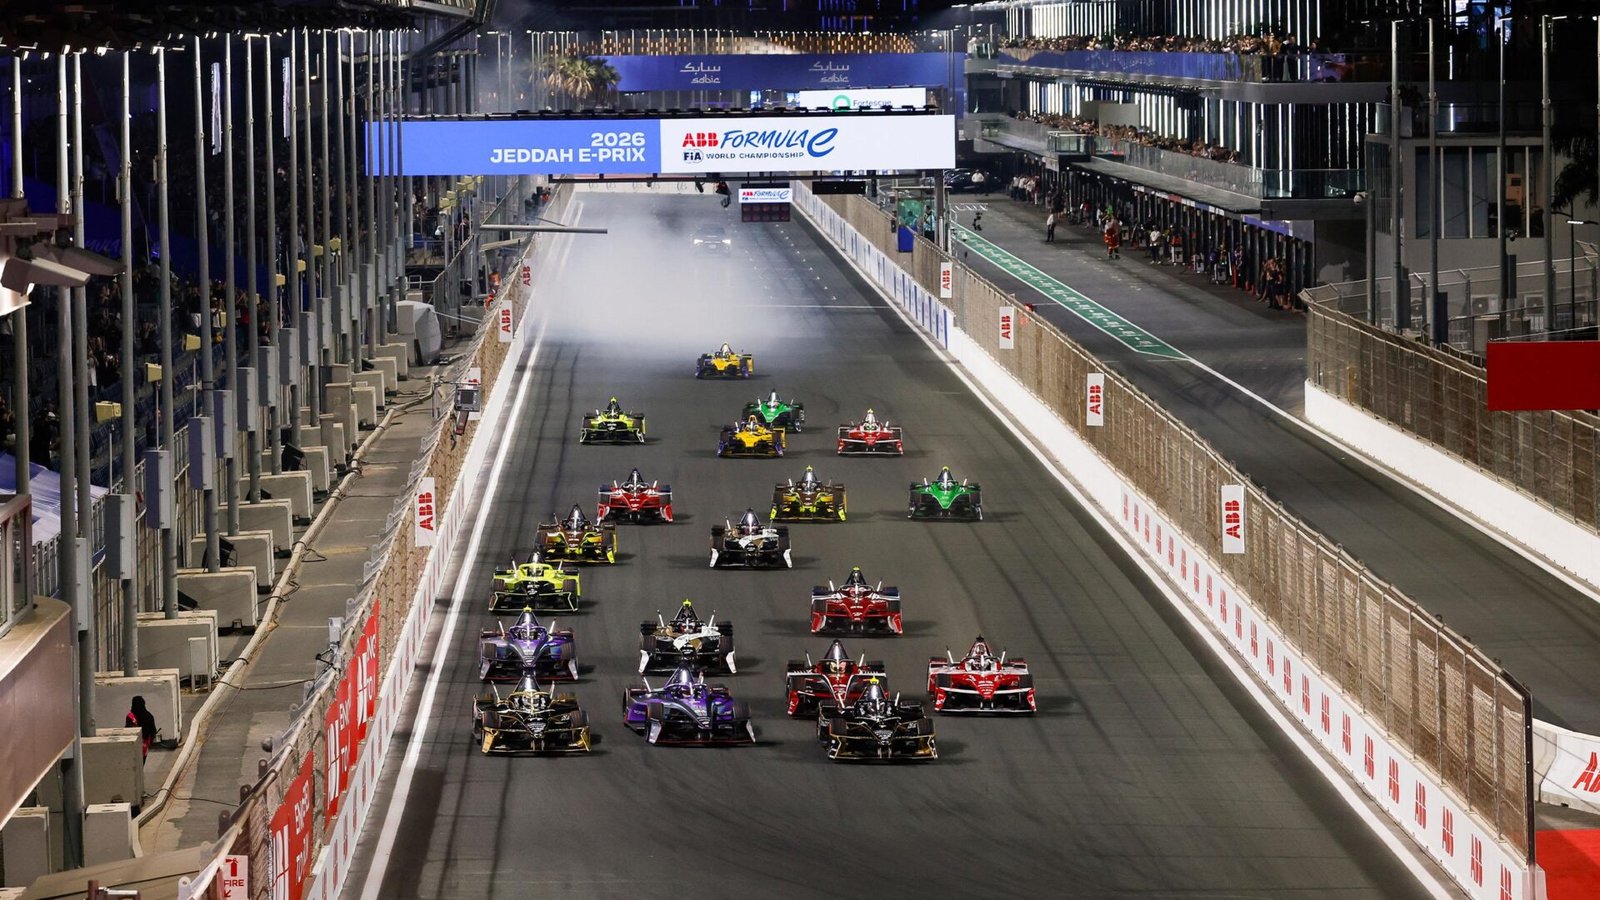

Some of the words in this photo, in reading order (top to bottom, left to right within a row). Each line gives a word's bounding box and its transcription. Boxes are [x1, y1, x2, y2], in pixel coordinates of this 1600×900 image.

[591, 132, 646, 147] 2026
[682, 132, 718, 147] ABB
[720, 129, 809, 149] FORMULA
[490, 148, 573, 164] JEDDAH
[579, 147, 646, 163] E-PRIX
[706, 152, 736, 160] WORLD
[739, 151, 804, 159] CHAMPIONSHIP
[522, 265, 531, 287] ABB
[942, 269, 951, 290] ABB
[501, 308, 511, 333] ABB
[1001, 315, 1011, 340] ABB
[1089, 384, 1101, 415] ABB
[418, 491, 434, 531] ABB
[1224, 499, 1241, 540] ABB
[224, 879, 245, 887] FIRE
